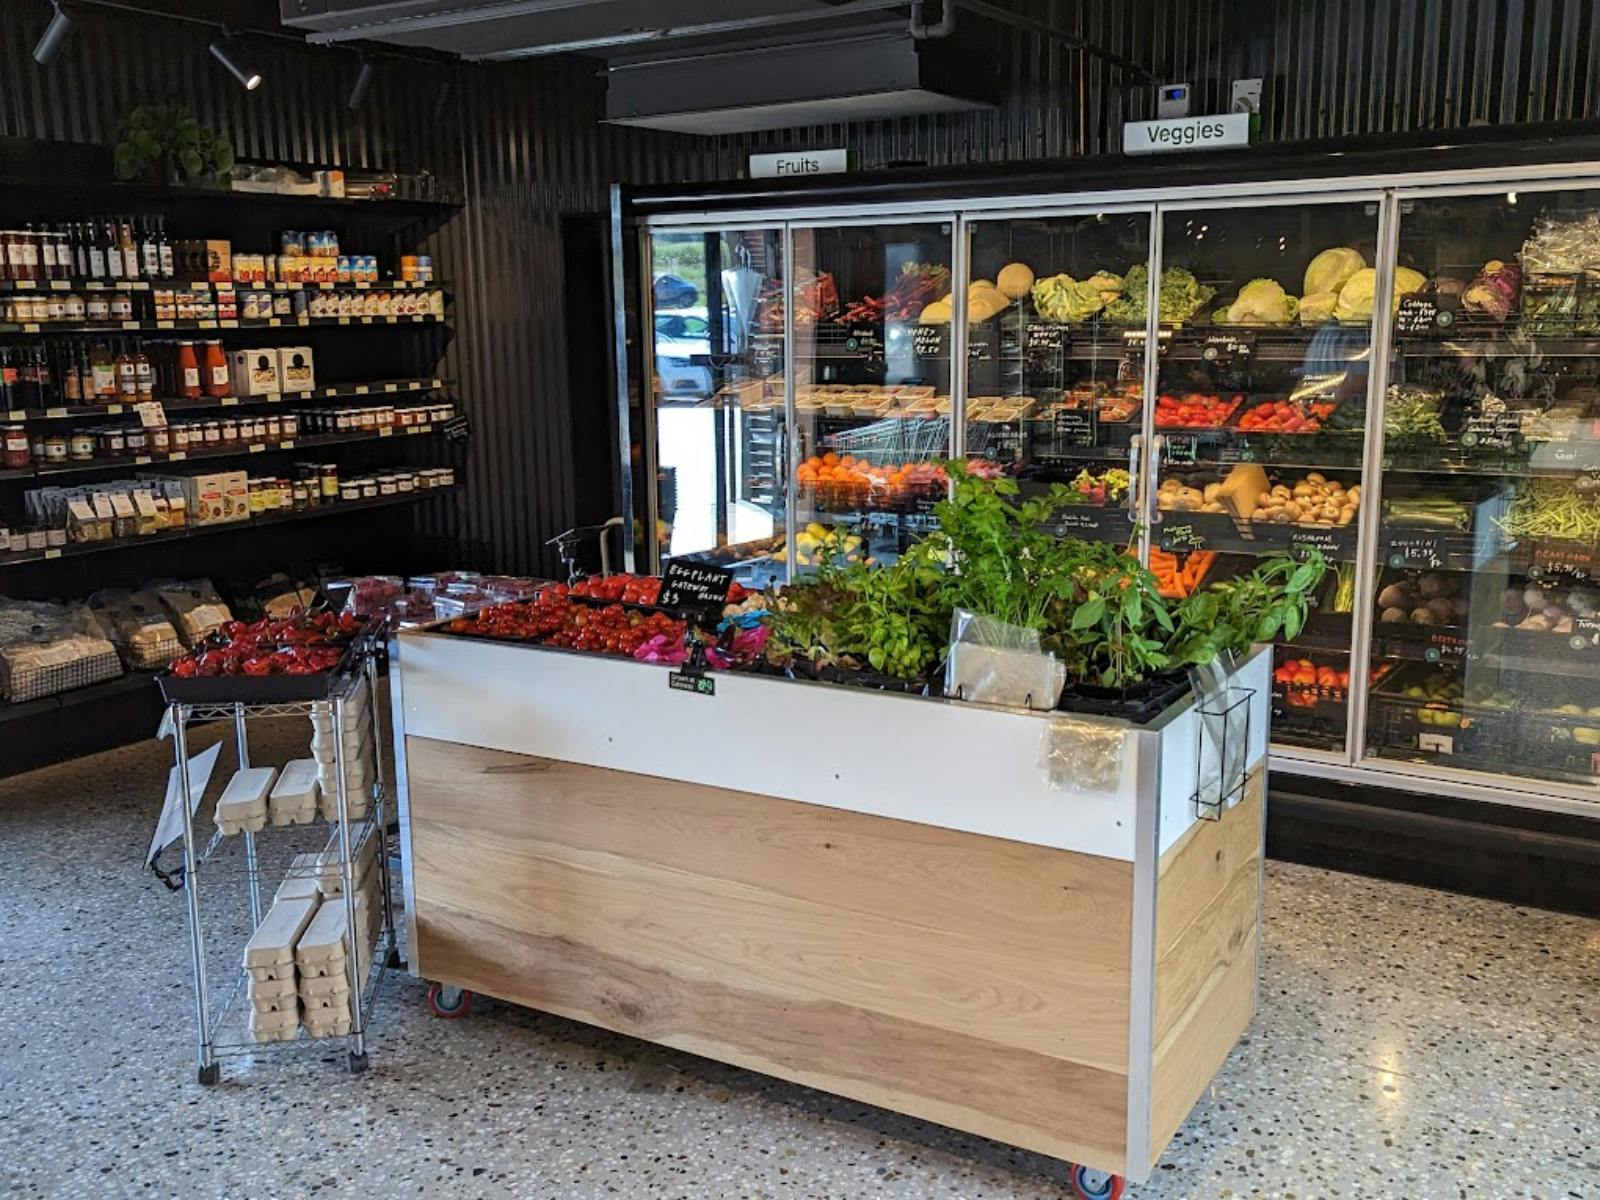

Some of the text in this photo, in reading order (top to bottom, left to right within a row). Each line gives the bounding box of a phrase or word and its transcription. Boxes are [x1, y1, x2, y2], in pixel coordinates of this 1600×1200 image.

[1147, 120, 1224, 144] Veggies
[776, 157, 820, 174] Fruits
[907, 328, 935, 338] HONEY
[914, 336, 942, 346] MELON
